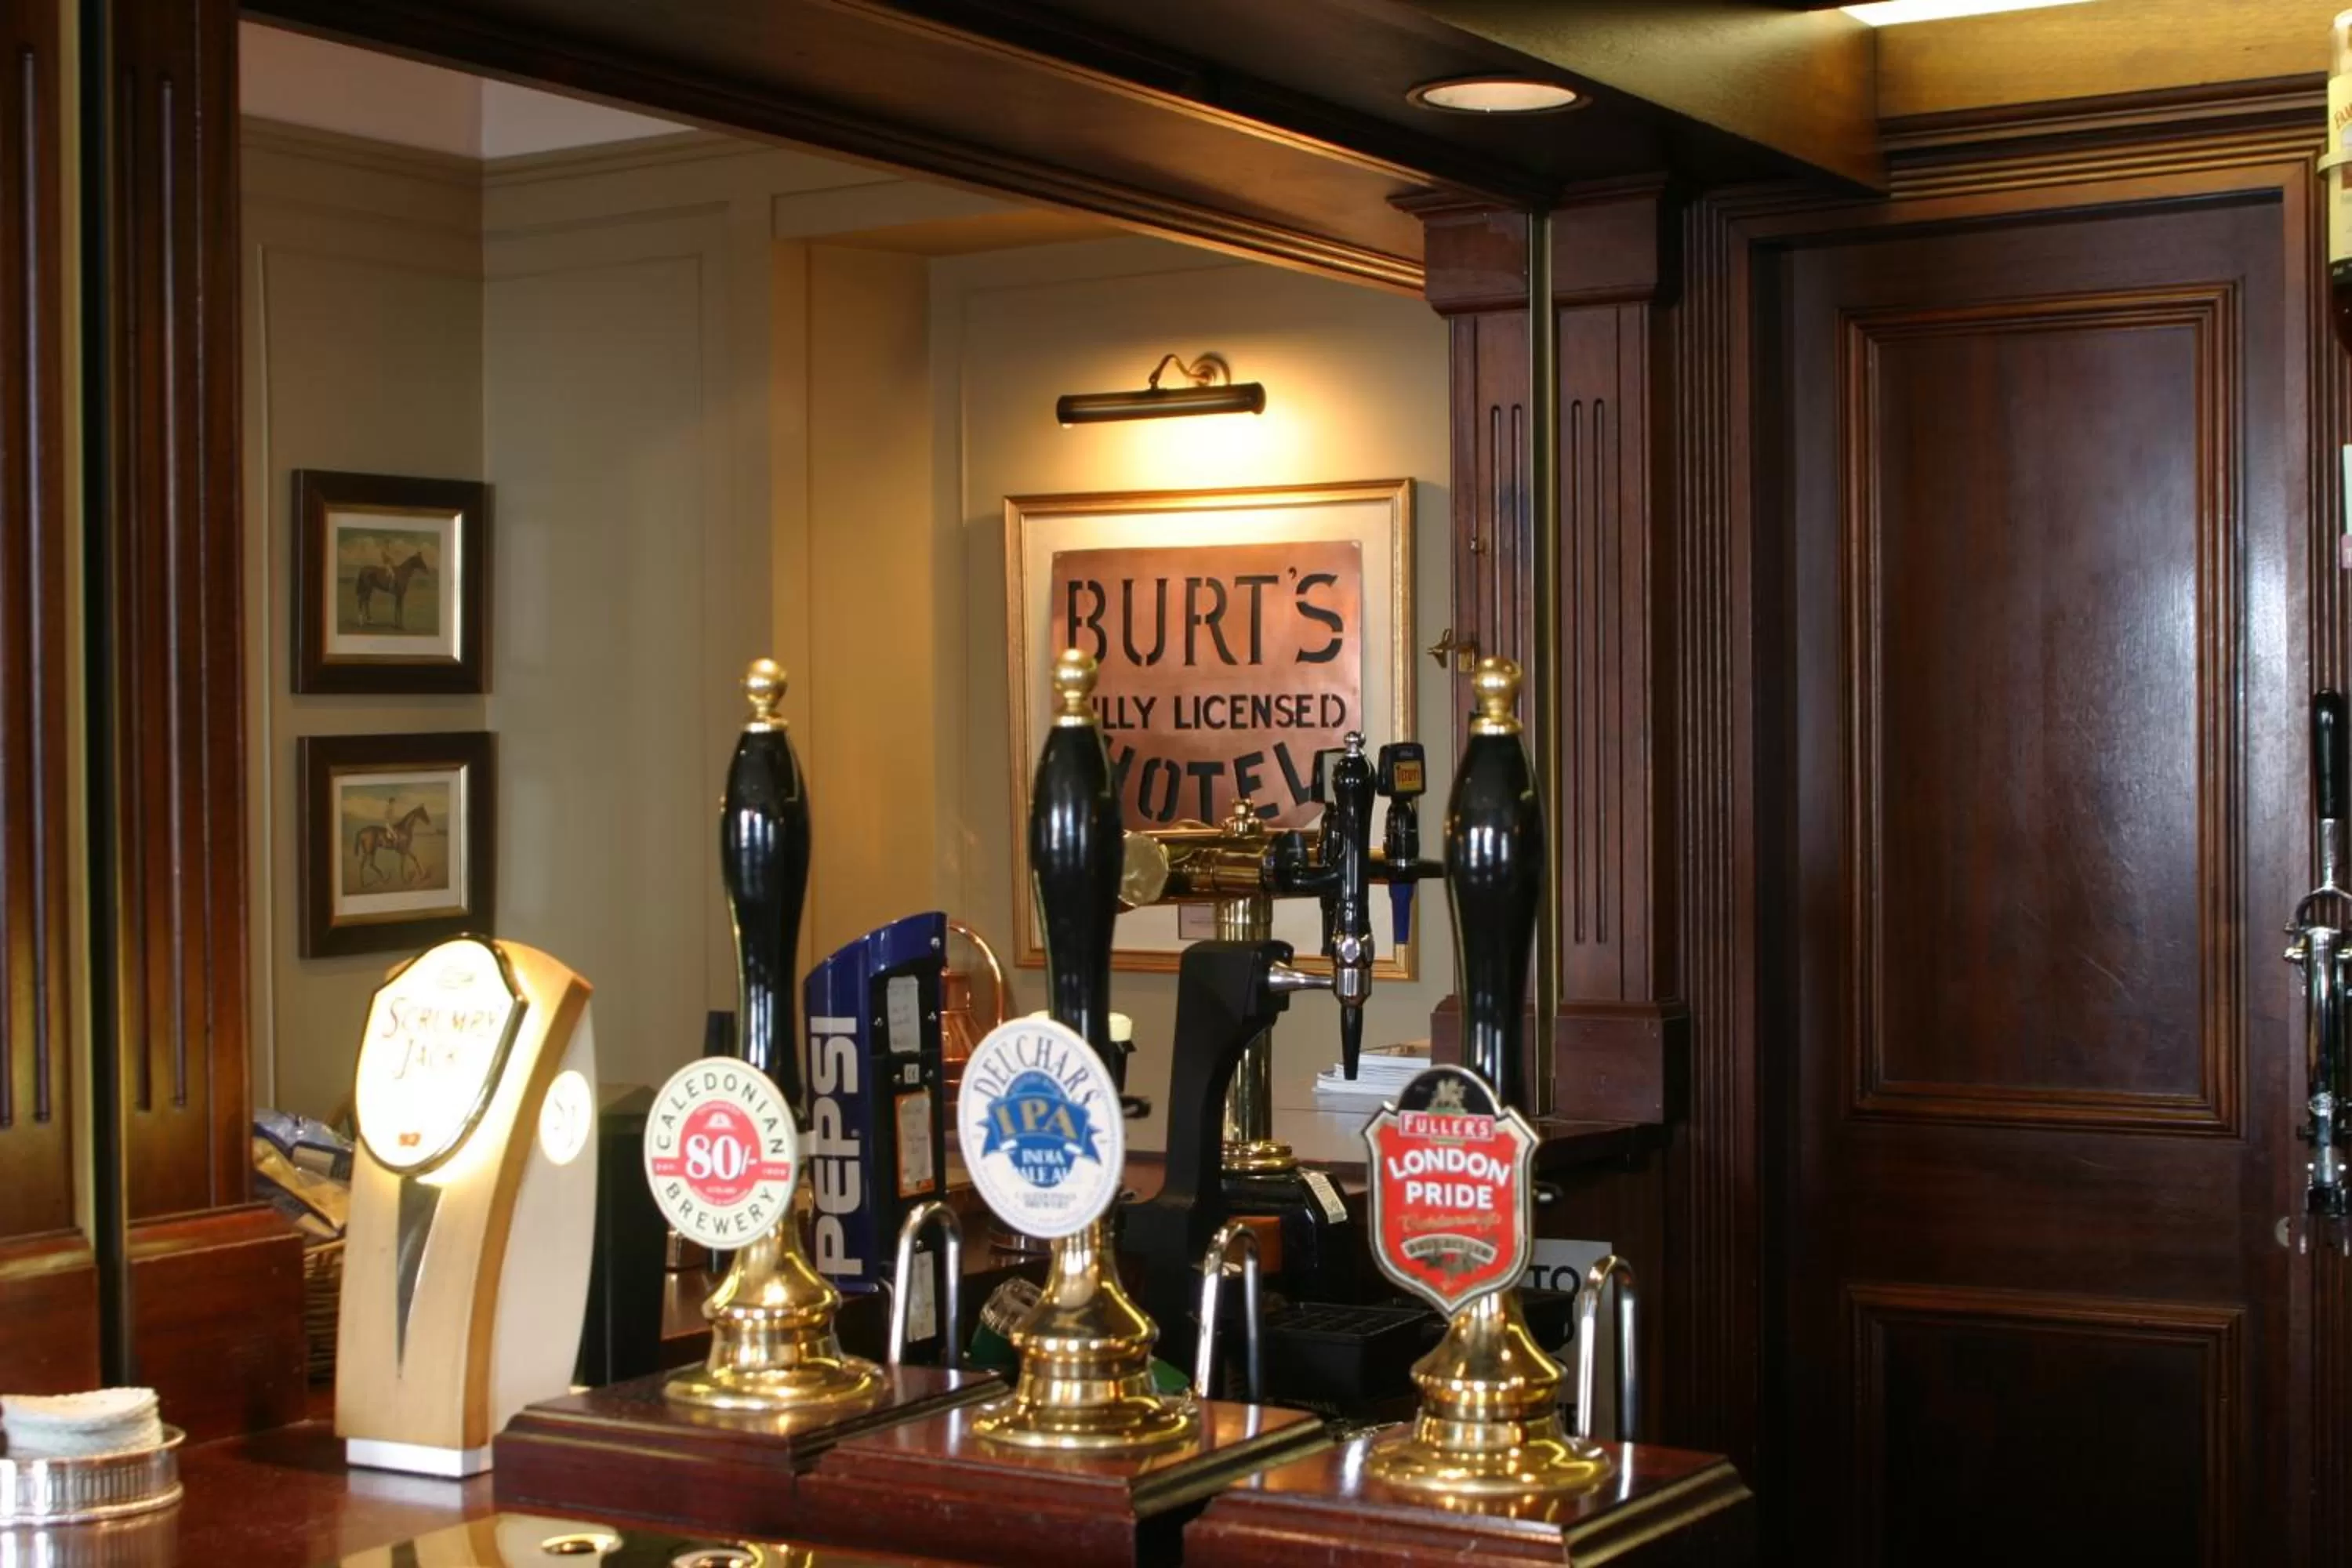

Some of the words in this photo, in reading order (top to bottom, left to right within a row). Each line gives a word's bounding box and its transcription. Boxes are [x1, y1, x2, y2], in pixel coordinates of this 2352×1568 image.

[1067, 567, 1344, 666] BURT'S
[1092, 695, 1157, 730] LLY
[1174, 693, 1346, 730] LICENSED
[973, 1033, 1103, 1106] DEUCHARS
[657, 1072, 785, 1155] CALEDONIAN
[994, 1099, 1078, 1139] IPA
[810, 1016, 862, 1276] PEPSI
[1388, 1147, 1511, 1187] LONDON
[666, 1182, 775, 1234] BREWERY
[1405, 1181, 1494, 1210] PRIDE
